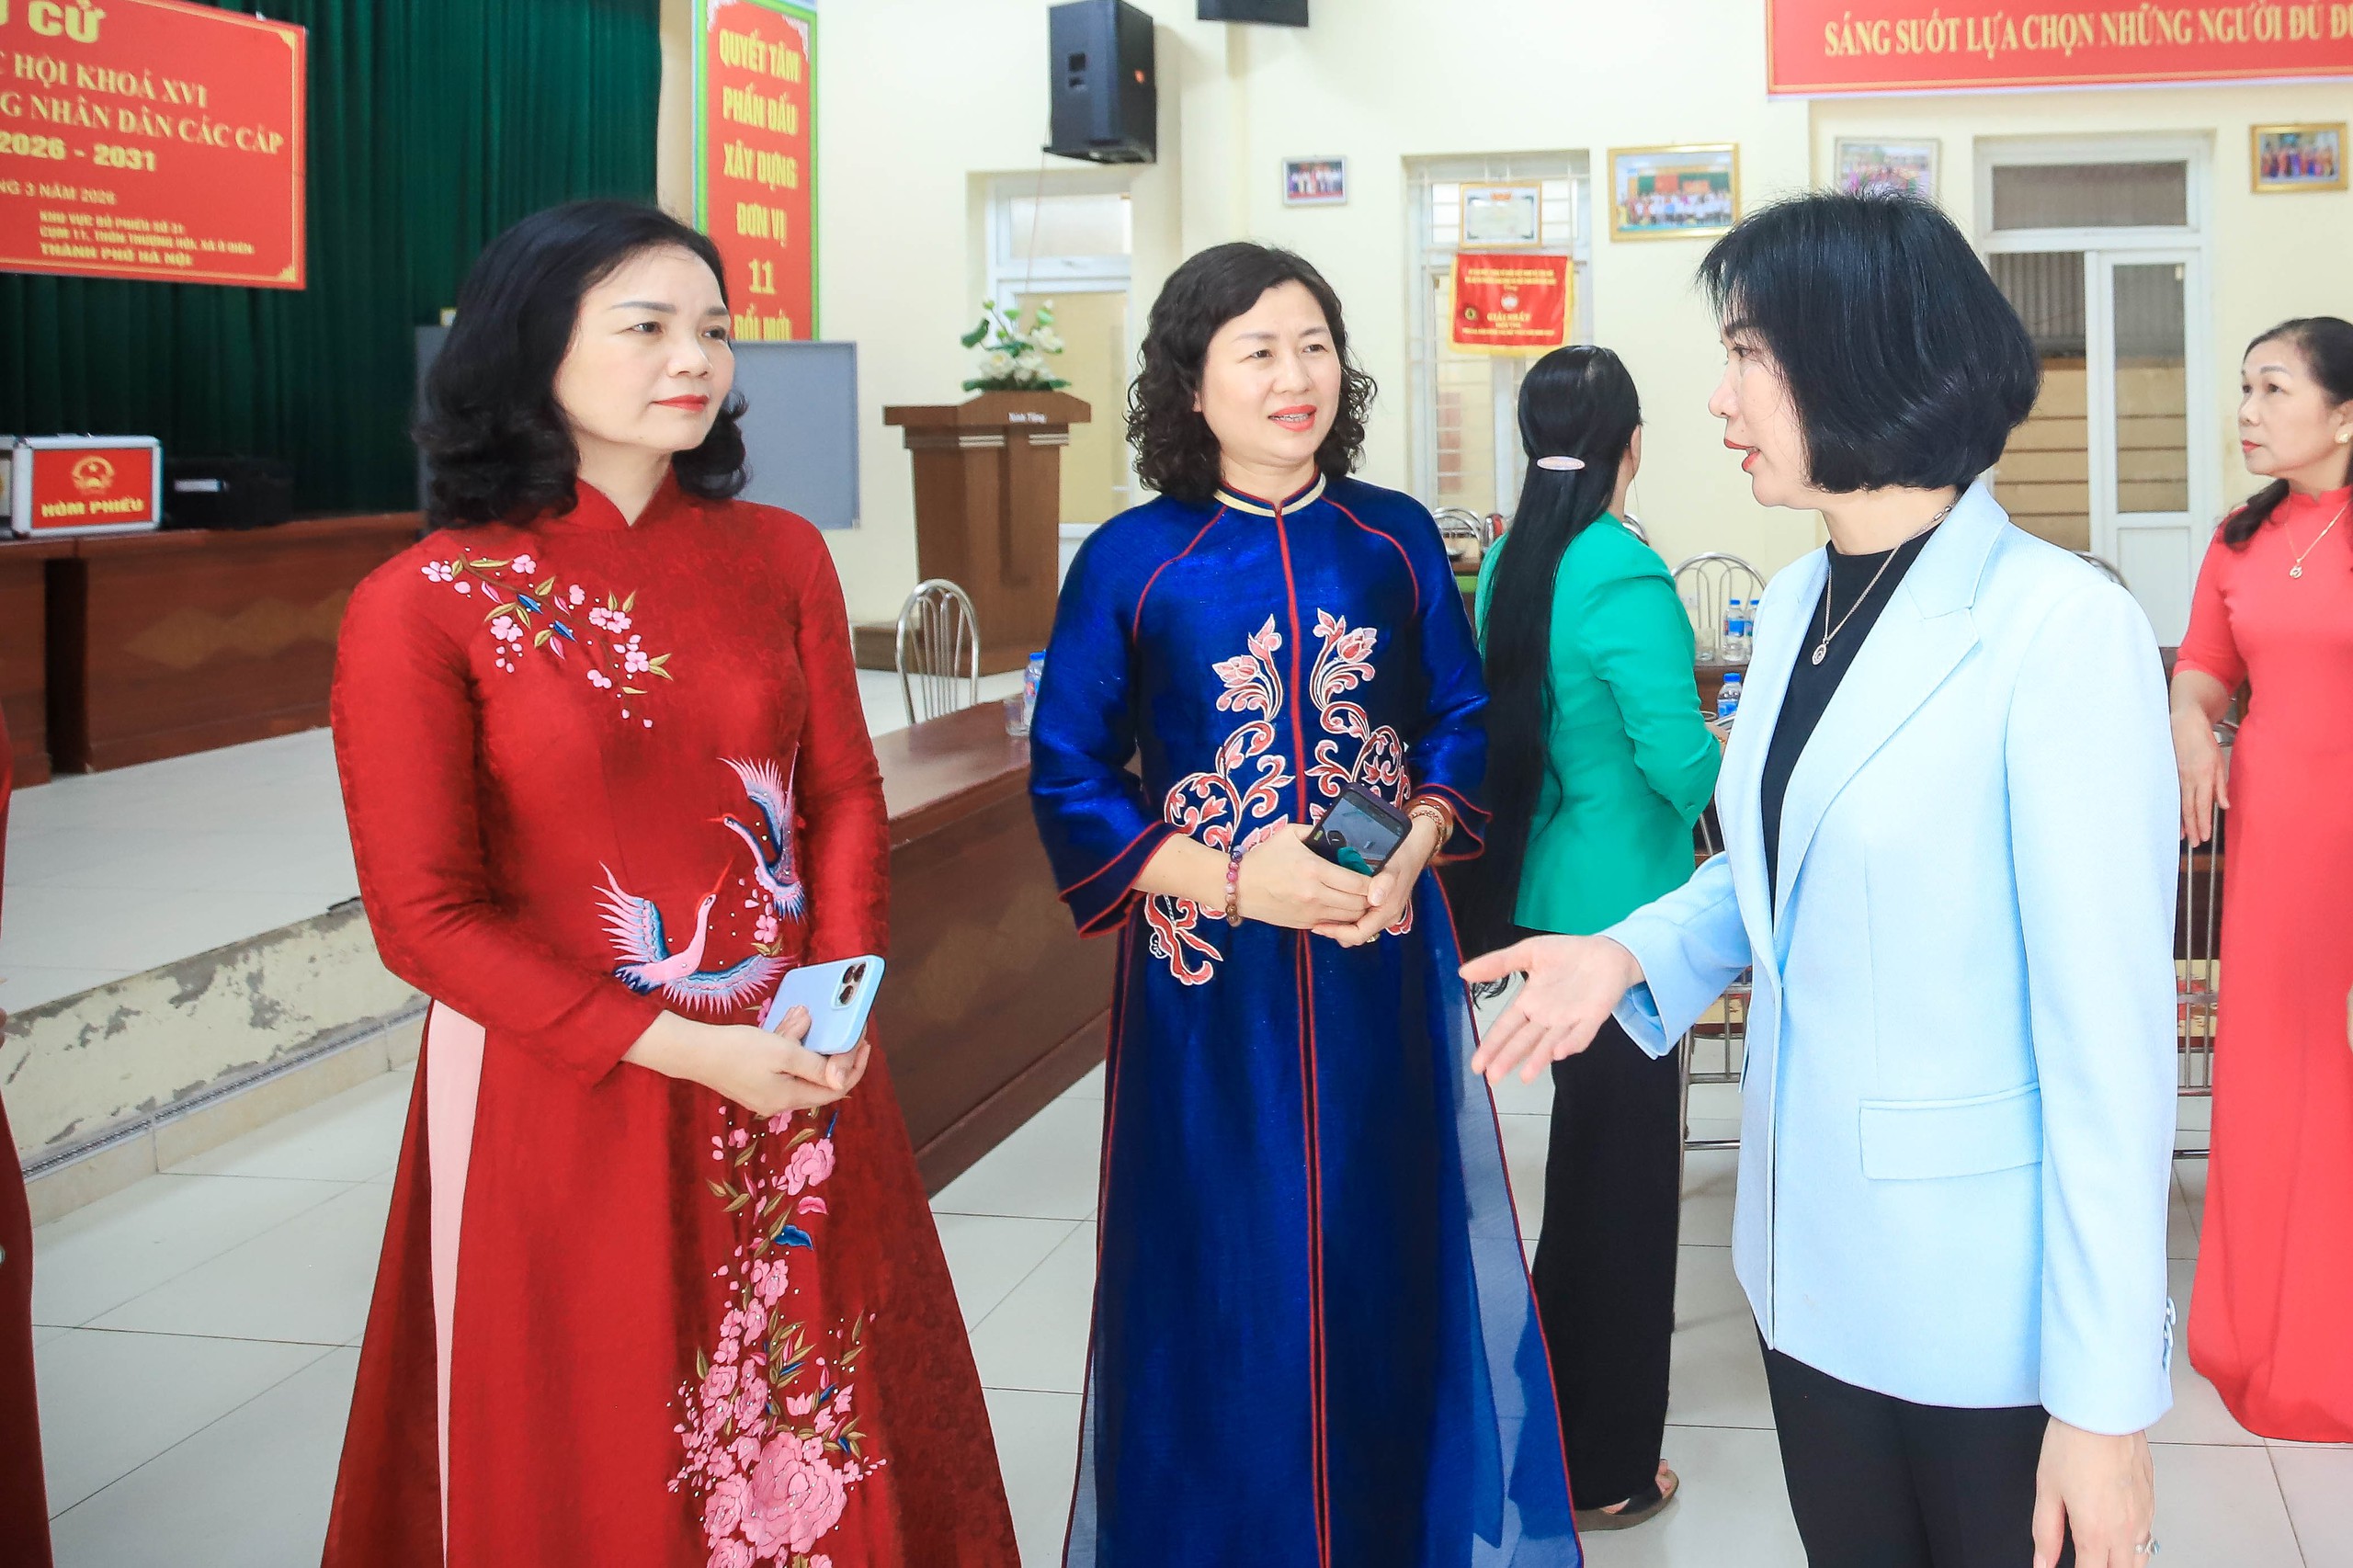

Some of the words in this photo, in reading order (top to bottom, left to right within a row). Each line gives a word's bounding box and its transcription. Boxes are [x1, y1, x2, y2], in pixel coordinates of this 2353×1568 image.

[719, 28, 767, 75] QUYẾT
[767, 40, 801, 85] TÂM
[1824, 10, 1892, 57] SÁNG
[1895, 7, 1961, 54] SUỐT
[1966, 11, 2018, 60] LỰA
[2022, 13, 2095, 57] CHỌN
[2099, 2, 2192, 47] NHỮNG
[2198, 0, 2282, 43] NGƯỜI
[14, 52, 67, 88] HỘI
[76, 62, 155, 101] KHOÁ
[162, 77, 207, 108] XVI
[30, 94, 110, 129] NHÂN
[118, 105, 173, 139] DÂN
[177, 115, 231, 148] CÁC
[722, 81, 767, 130] PHẤN
[767, 91, 799, 137] ĐẤU
[0, 131, 66, 161] 2026
[93, 143, 156, 172] 2031
[722, 138, 754, 181] XÂY
[756, 150, 799, 191] DỰNG
[770, 208, 787, 248] VỊ
[748, 258, 777, 295] 11
[40, 499, 85, 518] HÒM
[89, 495, 144, 515] PHIẾU
